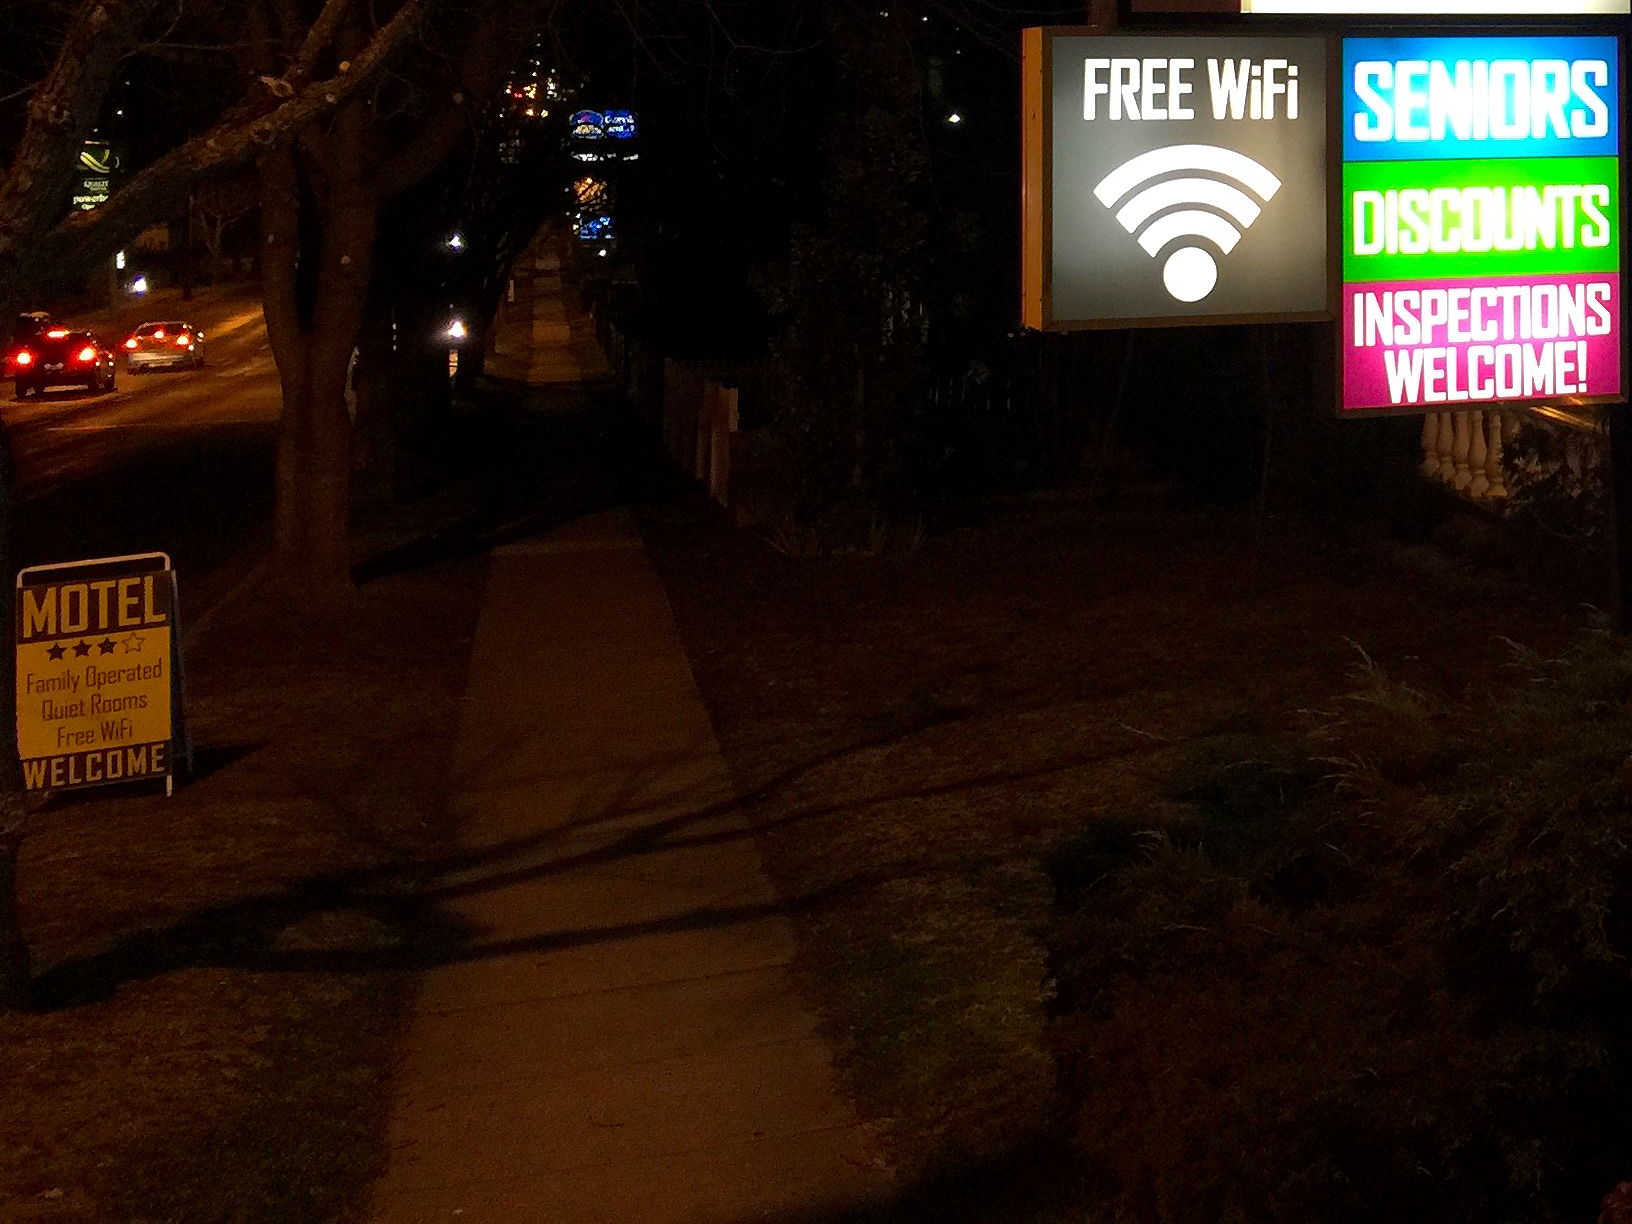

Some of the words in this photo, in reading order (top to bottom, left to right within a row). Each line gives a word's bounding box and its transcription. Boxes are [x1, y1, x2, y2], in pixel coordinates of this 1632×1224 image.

[1083, 58, 1196, 121] FREE
[1207, 58, 1300, 121] WiFi
[1353, 59, 1610, 142] SENIORS
[1352, 184, 1611, 256] DISCOUNTS
[1353, 282, 1613, 347] INSPECTIONS
[1383, 341, 1589, 405] WELCOME!
[23, 575, 166, 638] MOTEL
[26, 669, 80, 696] Family
[85, 657, 163, 690] Operated
[42, 699, 85, 722] Quiet
[90, 693, 149, 716] Rooms
[57, 725, 95, 748] Free
[101, 717, 133, 741] WiFi
[23, 743, 165, 790] WELCOME
